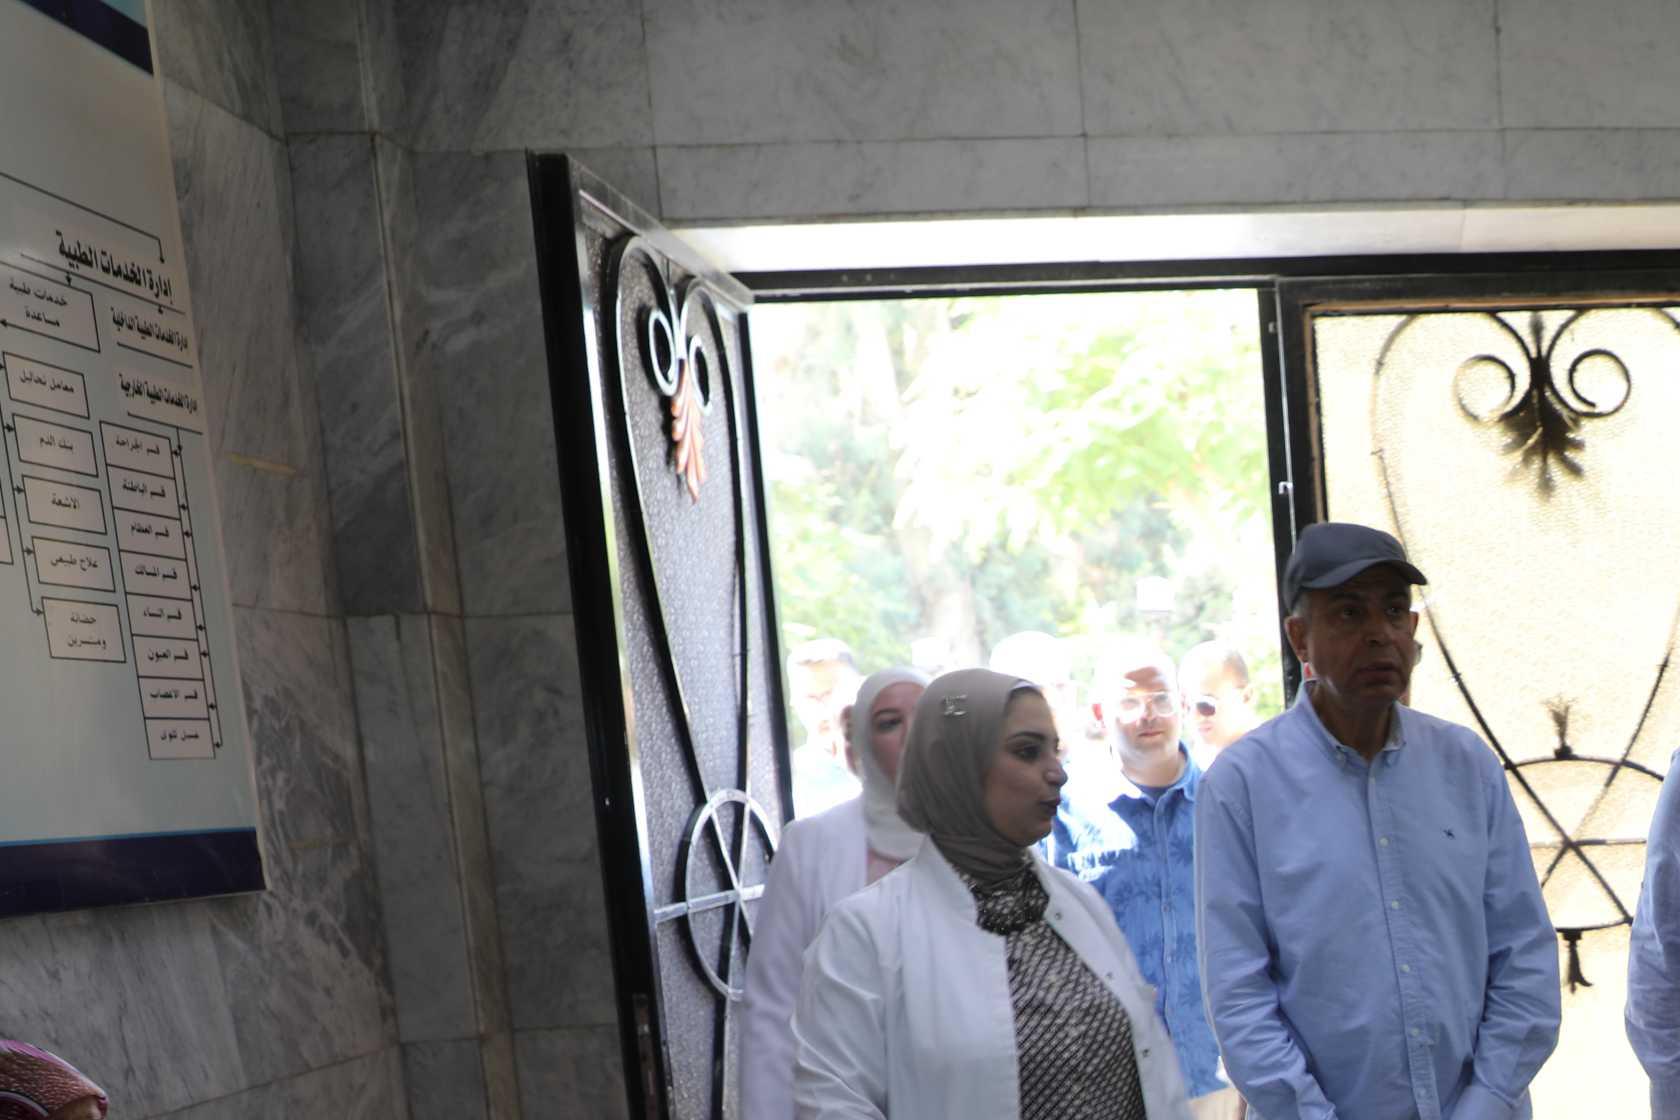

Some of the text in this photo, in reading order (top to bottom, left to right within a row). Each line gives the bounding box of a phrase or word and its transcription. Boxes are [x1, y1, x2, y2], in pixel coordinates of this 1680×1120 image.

[56, 229, 98, 271] الطبية
[100, 250, 146, 287] الخدمات
[9, 277, 68, 307] خدمات طبية
[24, 306, 61, 328] مساعدة
[49, 378, 75, 394] معامل
[39, 434, 56, 448] الدم
[147, 444, 160, 456] قسم
[150, 485, 166, 499] قسم
[155, 526, 170, 540] قسم
[162, 568, 178, 581] قسم
[167, 608, 183, 621] قسم
[174, 648, 189, 661] قسم
[184, 688, 199, 700] قسم
